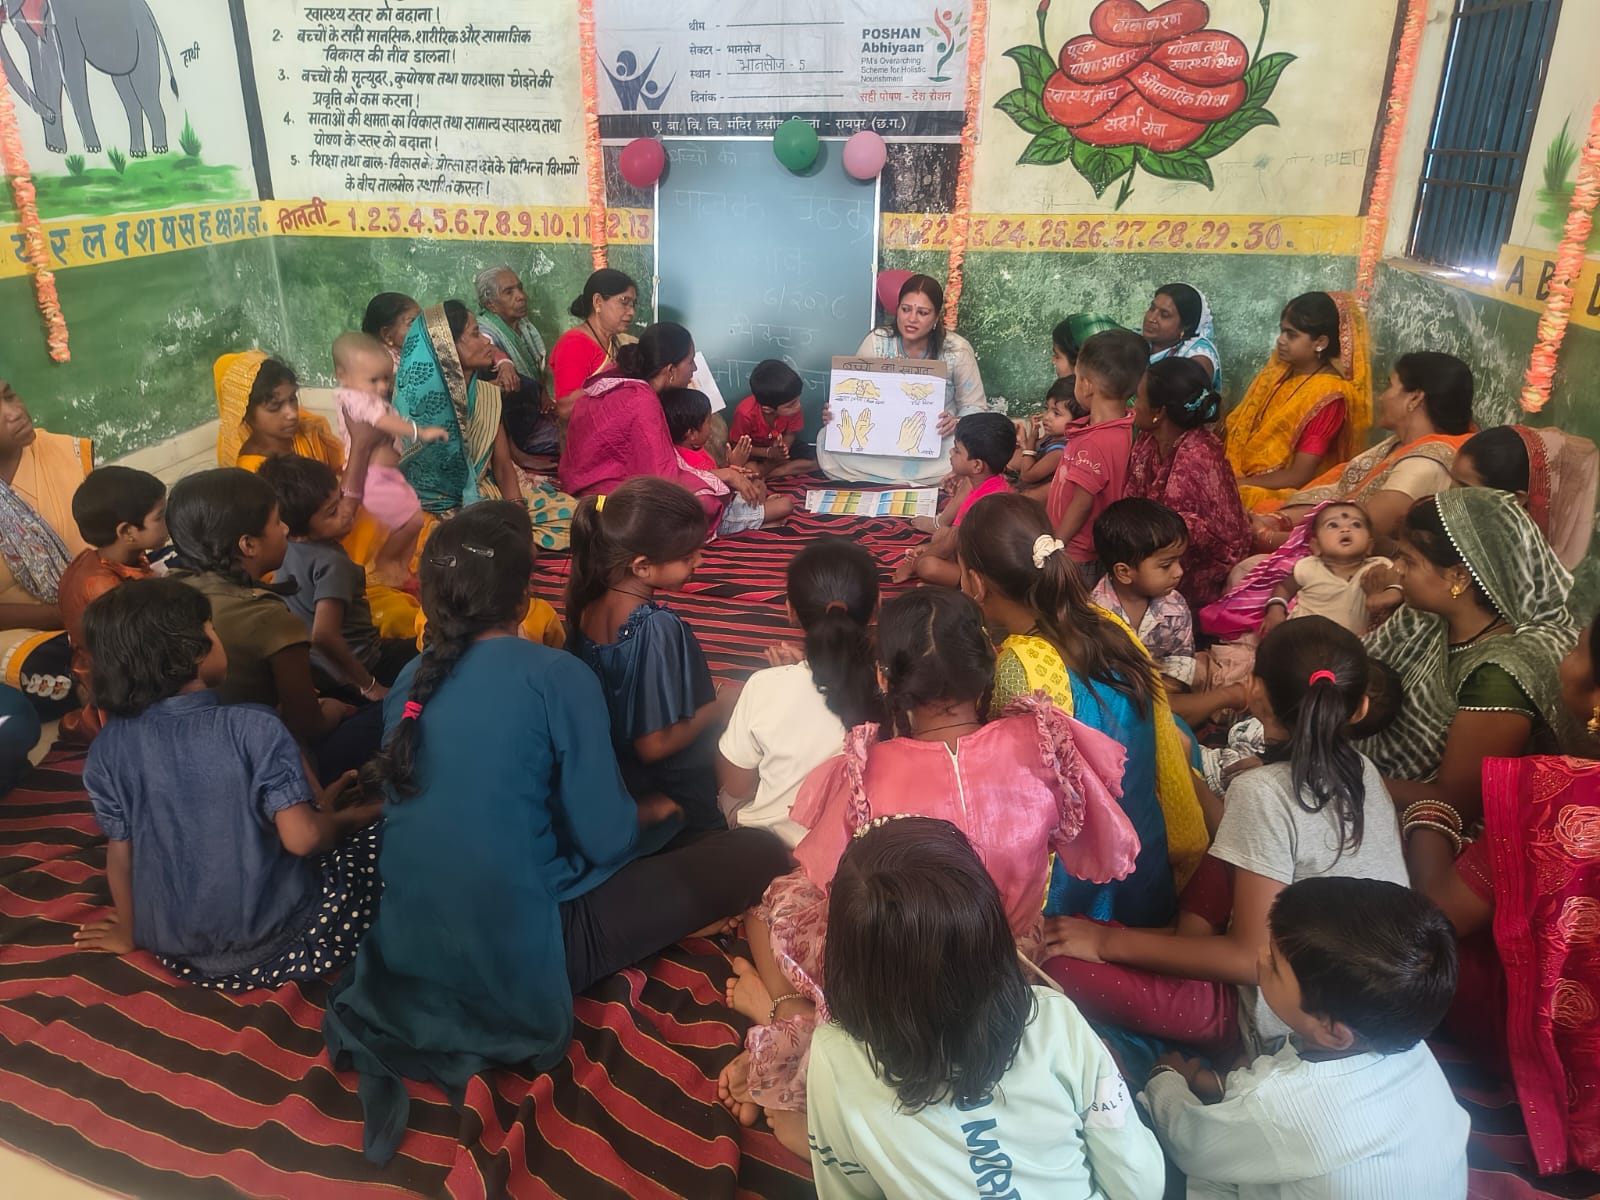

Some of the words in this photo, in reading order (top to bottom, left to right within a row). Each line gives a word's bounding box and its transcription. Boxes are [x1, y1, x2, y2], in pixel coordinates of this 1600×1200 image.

[348, 8, 373, 23] स्तर
[376, 1, 393, 22] को
[688, 19, 705, 31] थीम
[862, 28, 921, 39] POSHAN
[328, 25, 339, 42] के
[341, 25, 365, 44] सही
[460, 24, 481, 46] और
[482, 25, 531, 44] सामाजिक
[180, 41, 201, 68] हाथी
[323, 44, 365, 62] विकास
[368, 45, 384, 62] की
[689, 43, 713, 55] सेक्टर
[727, 41, 761, 54] भानसोज
[861, 42, 924, 55] Abhiyaan
[1204, 40, 1230, 53] तथा
[861, 57, 878, 65] PM's
[879, 57, 921, 65] Overarching
[1101, 48, 1139, 71] आहार
[333, 65, 348, 83] की
[437, 72, 459, 86] तथा
[461, 73, 505, 87] पाठशाला
[537, 69, 554, 89] की
[690, 69, 711, 79] स्थान
[860, 75, 904, 83] Nourishment
[344, 87, 359, 106] को
[360, 92, 379, 106] कम
[690, 90, 717, 103] दिनांक
[860, 90, 876, 103] सही
[879, 90, 901, 102] पोषण
[912, 90, 926, 101] देश
[929, 89, 952, 101] रोशन
[308, 108, 345, 127] माताओं
[347, 108, 361, 127] की
[363, 113, 391, 128] क्षमता
[391, 114, 406, 129] का
[406, 109, 443, 130] विकास
[443, 116, 463, 131] तथा
[464, 117, 501, 132] सामान्य
[542, 119, 562, 134] तथा
[727, 116, 751, 131] मंदिर
[835, 118, 866, 132] रायपुर
[313, 129, 342, 147] पोषण
[344, 130, 357, 147] के
[357, 134, 382, 149] स्तर
[382, 130, 397, 148] को
[309, 150, 338, 168] शिक्षा
[340, 155, 362, 168] तथा
[344, 173, 355, 192] के
[357, 173, 377, 192] बीच
[378, 173, 415, 193] तालमेल
[277, 197, 328, 234] गिनती
[961, 1118, 1022, 1200] MOR
